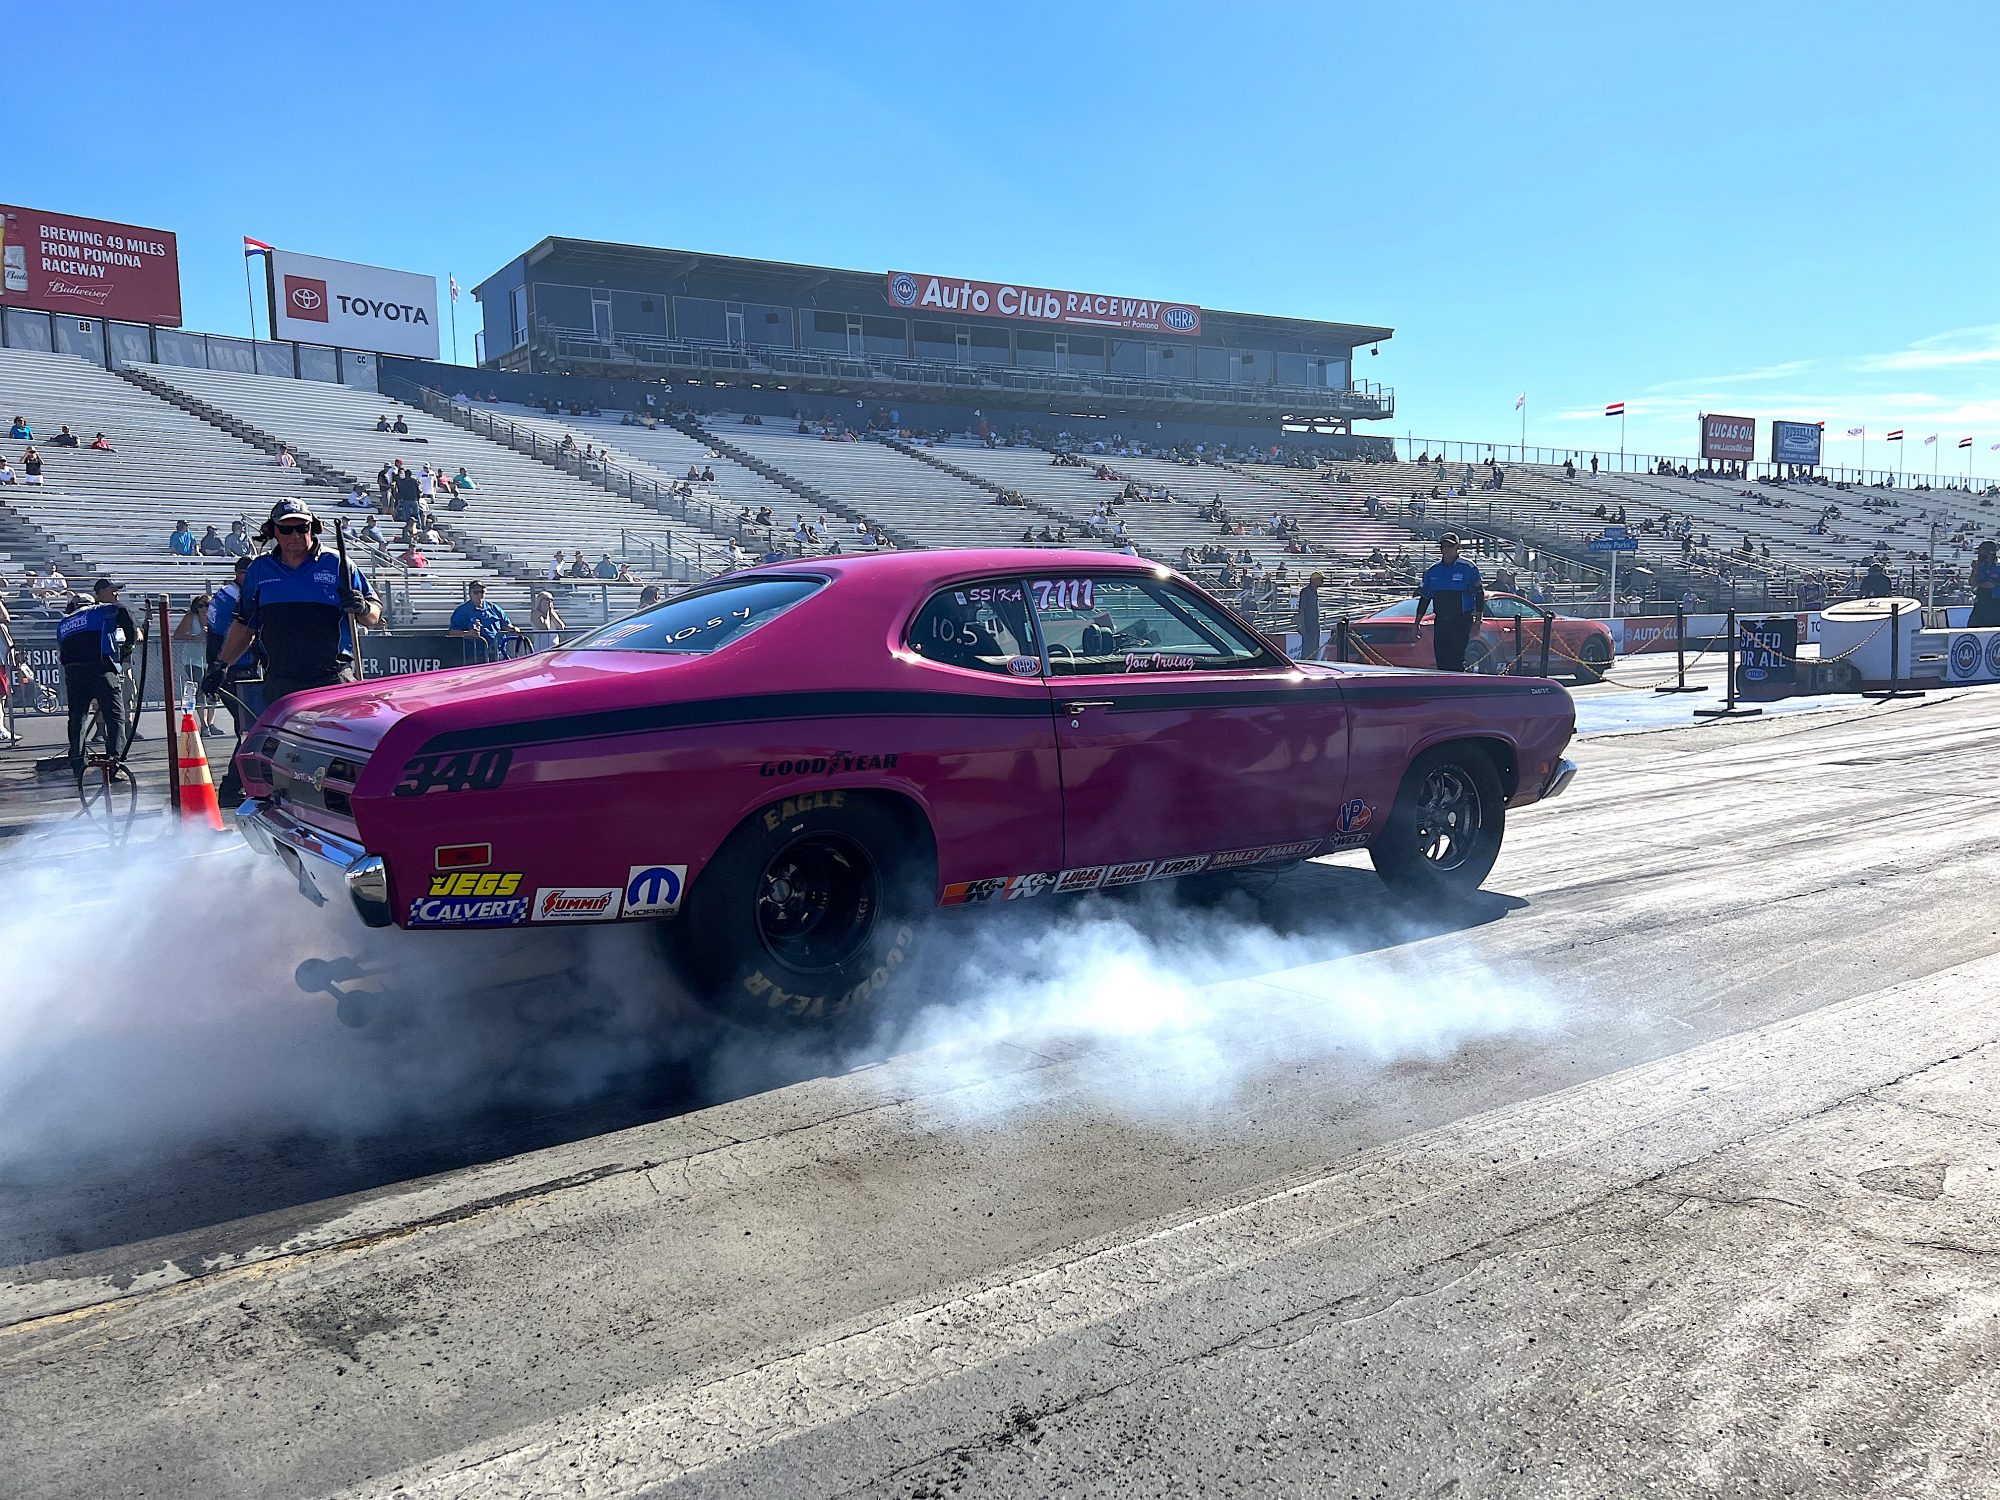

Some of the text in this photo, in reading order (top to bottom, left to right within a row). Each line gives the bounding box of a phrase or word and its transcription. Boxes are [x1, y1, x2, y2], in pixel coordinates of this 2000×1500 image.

[40, 225, 165, 257] BREWING 49 MILES
[41, 241, 142, 269] FROM POMONA
[42, 257, 105, 279] RACEWAY
[49, 281, 108, 299] Budweiser
[920, 278, 990, 313] Auto
[997, 286, 1061, 320] Club
[1066, 293, 1161, 320] RACEWAY
[336, 294, 429, 326] TOYOTA
[79, 321, 91, 331] BB
[1132, 321, 1159, 330] Pomona
[1166, 313, 1195, 328] NHRA
[357, 355, 366, 364] CC
[664, 385, 673, 393] 2
[855, 400, 863, 408] 3
[1708, 423, 1753, 440] LUCAS OIL
[1032, 579, 1094, 610] 7111
[1632, 626, 1661, 641] AUTO
[1741, 632, 1781, 649] SPEED
[1125, 653, 1195, 673] Jon Irving
[1742, 651, 1786, 668] OR ALL
[1960, 648, 1975, 662] AAA
[389, 656, 441, 674] DRIVER
[1012, 661, 1036, 670] NHRA
[394, 748, 514, 798] 340
[763, 790, 845, 833] EAGLE
[1340, 799, 1365, 831] VP
[1336, 834, 1369, 846] WELD
[1213, 850, 1263, 864] MANLEY
[1267, 842, 1314, 858] MANLEY
[1060, 868, 1103, 884] LUCAS
[1109, 863, 1151, 878] LUCAS
[429, 872, 523, 896] JEGS
[418, 899, 520, 921] CALVERT
[623, 907, 675, 917] MOPAR
